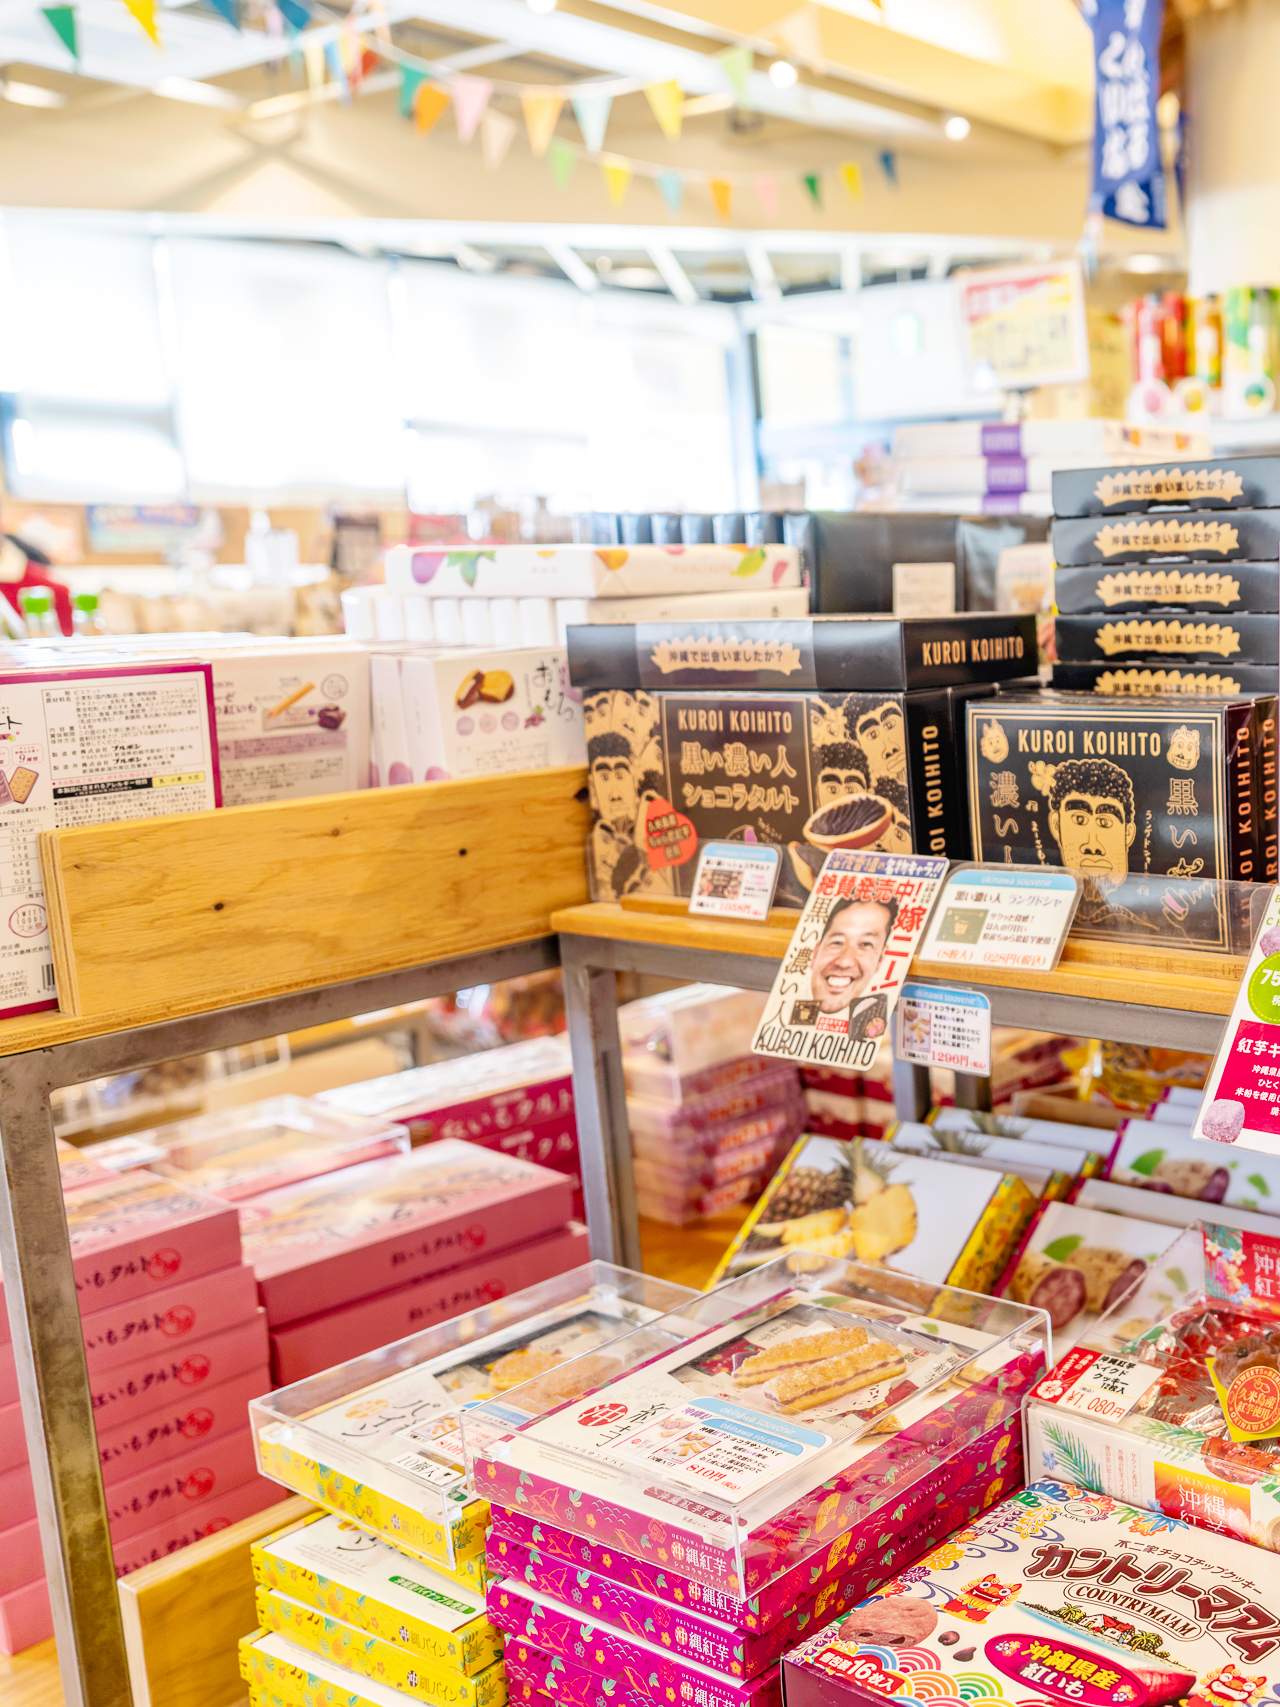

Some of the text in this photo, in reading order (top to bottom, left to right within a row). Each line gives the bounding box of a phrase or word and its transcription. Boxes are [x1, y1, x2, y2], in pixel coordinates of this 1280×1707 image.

[922, 636, 1024, 667] KUROI KOIHITO
[678, 709, 792, 734] KUROI KOIHITO
[1018, 730, 1161, 756] KUROI KOIHITO
[680, 740, 797, 779] 黒い濃い人
[922, 725, 943, 818] KOIHITO
[1263, 718, 1277, 822] KOIHITO
[1236, 727, 1251, 833] KOIHITO
[681, 784, 799, 813] ショコラタルト
[806, 1031, 876, 1066] KOIHITO
[1092, 1363, 1129, 1377] ベイクド
[1098, 1355, 1137, 1369] 沖縄紅芋
[1093, 1373, 1129, 1387] クッキー
[1100, 1382, 1126, 1395] 12枚入
[1236, 1400, 1272, 1420] 紅芋使用
[1239, 1387, 1279, 1409] 久米島産
[1229, 1410, 1269, 1431] OKINAWA
[720, 1422, 790, 1450] okinawa souvenir
[1176, 1474, 1228, 1496] OKINAWA
[1179, 1484, 1226, 1519] 沖縄
[671, 1541, 727, 1576] 沖縄紅芋
[1114, 1538, 1262, 1595] 不二家チョコチップクッキー
[674, 1561, 727, 1585] ショコラサンドパイ
[688, 1581, 744, 1616] 沖縄紅芋
[690, 1601, 744, 1625] ショコラサンドパイ
[675, 1625, 729, 1662] 沖縄紅芋
[677, 1646, 729, 1671] ショコラサンドパイ
[1021, 1640, 1124, 1692] 沖縄県産
[1019, 1666, 1085, 1698] 紅いも
